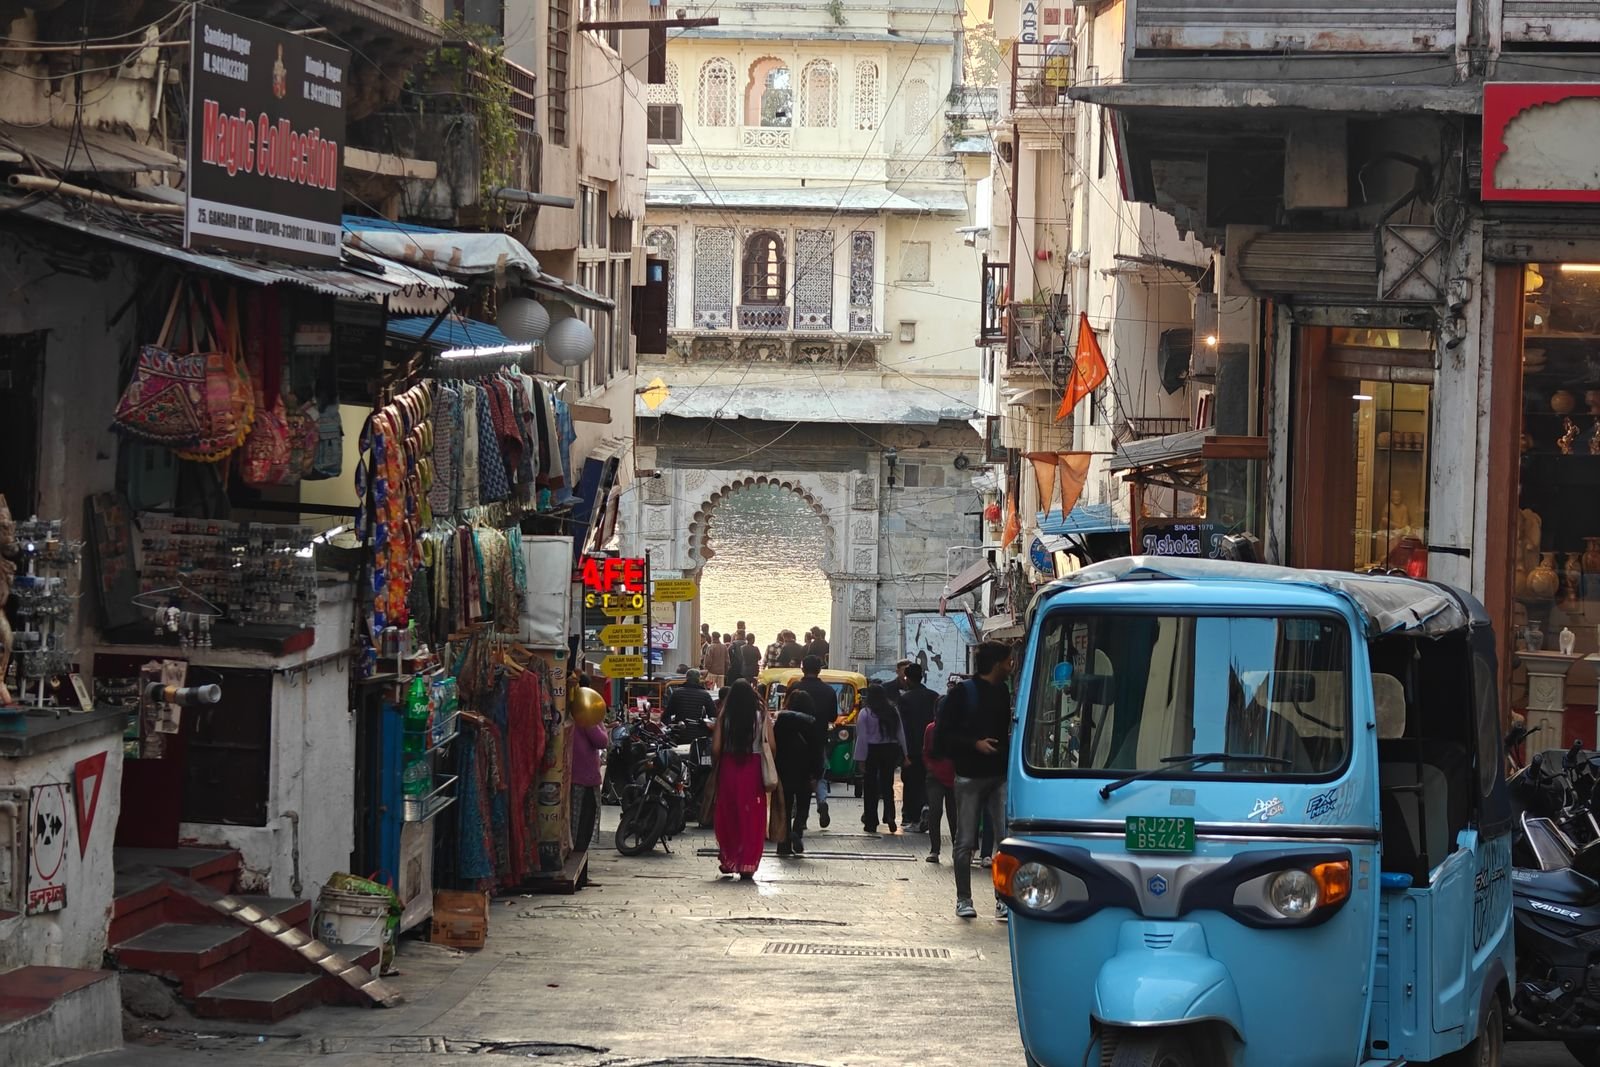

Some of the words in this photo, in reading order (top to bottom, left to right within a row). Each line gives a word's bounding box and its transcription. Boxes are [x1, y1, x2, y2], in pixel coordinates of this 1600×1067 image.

[204, 24, 232, 52] Sandeep
[232, 33, 251, 56] Nagar
[202, 99, 255, 176] Magic
[256, 112, 338, 191] Collection
[208, 210, 237, 229] GANGAUR
[1142, 534, 1200, 556] Ashoka
[583, 558, 644, 592] AFE
[1306, 788, 1337, 814] FX
[1138, 817, 1185, 833] RJ27P
[1138, 833, 1186, 848] B5442
[1528, 899, 1582, 920] RAIDER
